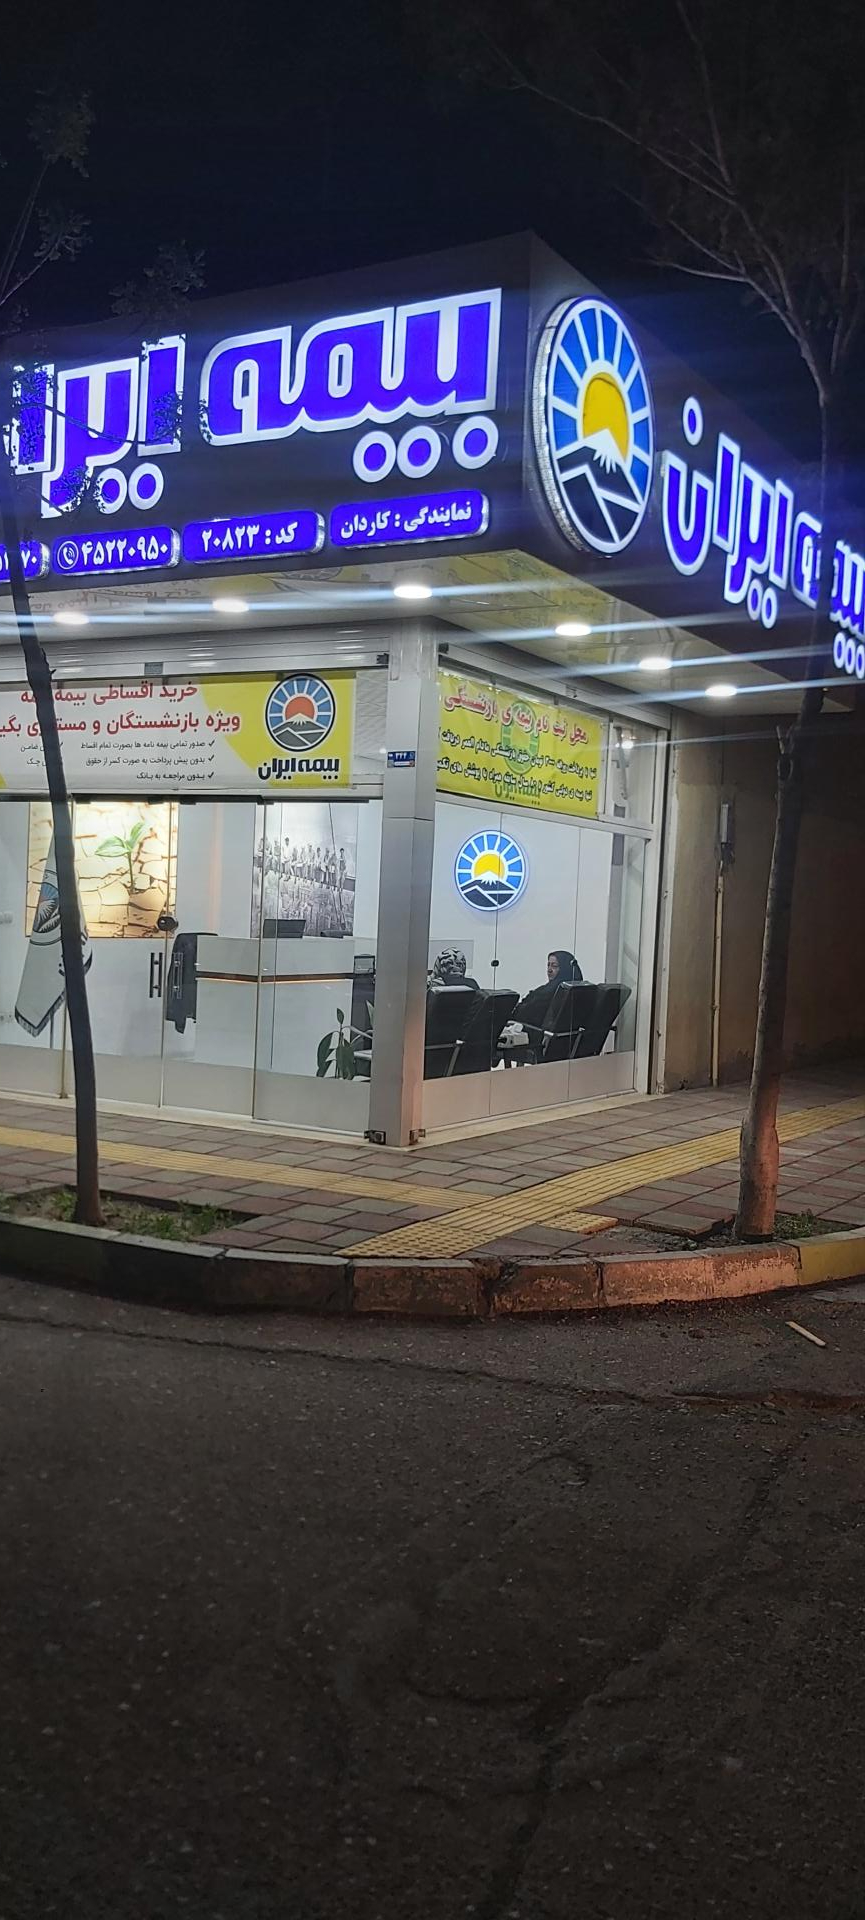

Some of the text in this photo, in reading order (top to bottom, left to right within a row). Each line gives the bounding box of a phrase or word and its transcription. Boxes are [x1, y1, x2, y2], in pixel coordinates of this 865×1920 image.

[3, 288, 502, 519] بیمه ایرا
[403, 501, 473, 533] نمایندگی
[661, 397, 794, 629] ایران
[340, 510, 391, 539] کاردان
[201, 523, 260, 553] ۲۰۸۲۳
[275, 522, 298, 545] کد
[81, 535, 168, 566] ۴۵۲۲۰۹۵۰
[93, 682, 154, 706] اقساطی
[159, 681, 198, 703] خرید
[54, 688, 87, 706] بیمه
[444, 685, 498, 722] بازنشستگی
[0, 709, 241, 737] ویژه بازنشستگان و مستی بگی
[569, 723, 588, 746] محل
[20, 743, 39, 752] ضامن
[99, 742, 112, 751] تمام
[114, 742, 133, 751] بصورت
[143, 741, 155, 749] نامه
[157, 741, 169, 750] بیمه
[170, 740, 188, 750] تمامی
[189, 741, 206, 750] صدور
[86, 758, 102, 767] حقوق
[103, 757, 108, 766] از
[109, 757, 121, 766] کسر
[122, 758, 140, 767] صورت
[149, 757, 172, 766] پرداخت
[174, 757, 189, 766] پیش
[190, 757, 206, 766] بدون
[258, 757, 340, 780] بیمه ایران
[136, 773, 153, 781] بانک
[162, 773, 186, 782] مراجعه
[187, 773, 206, 781] بدون
